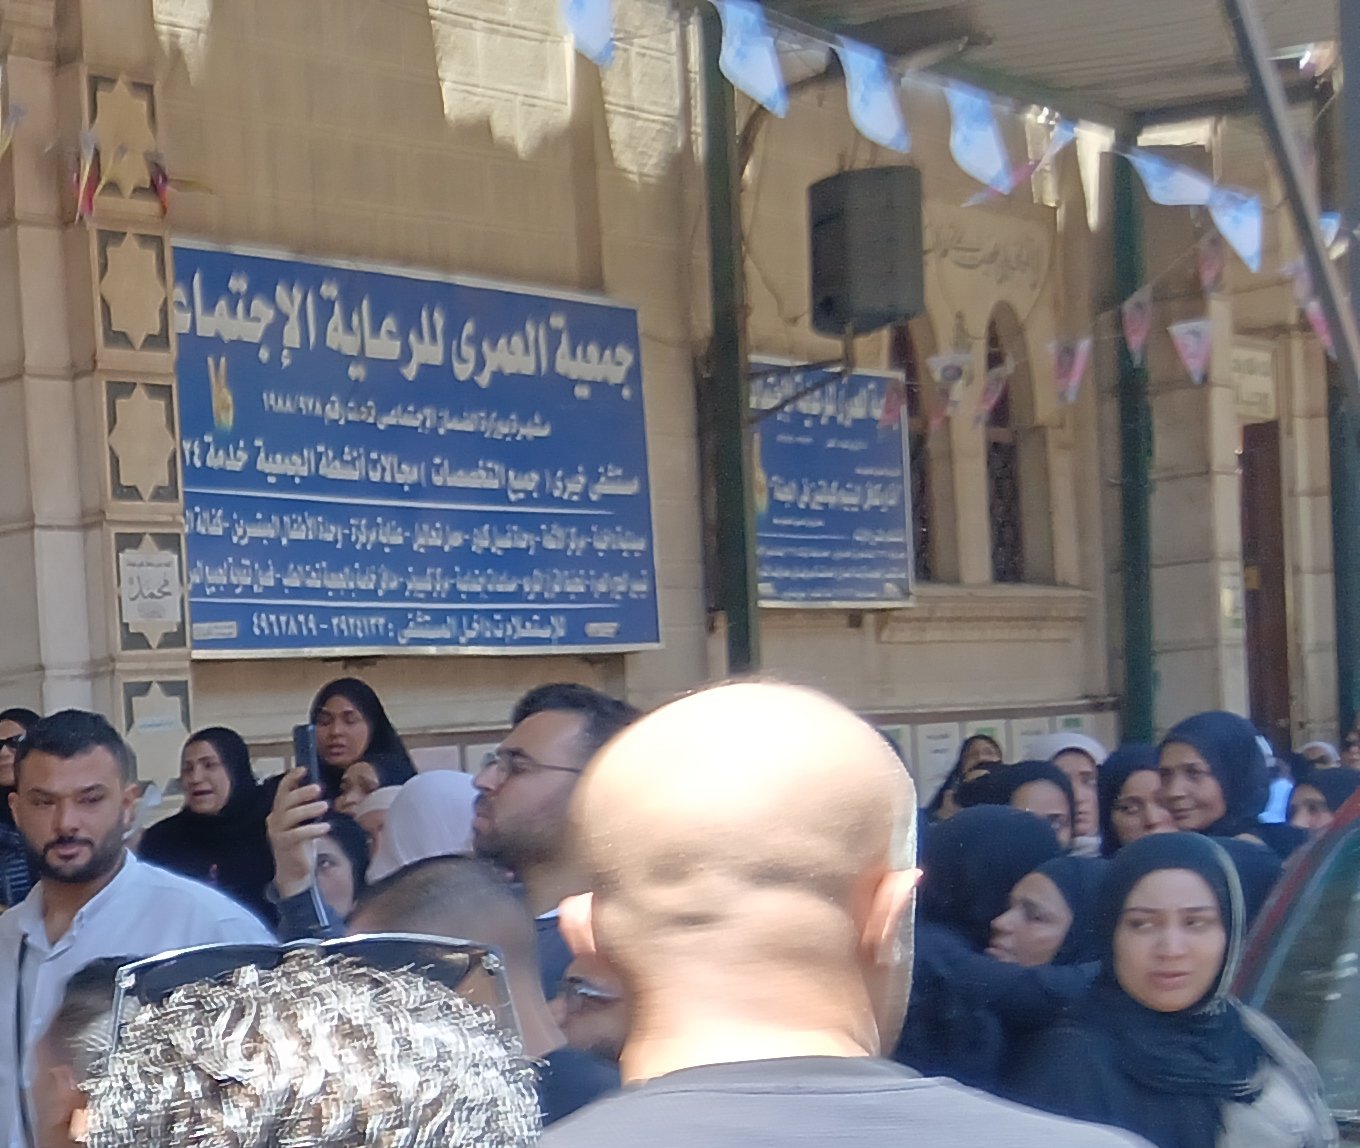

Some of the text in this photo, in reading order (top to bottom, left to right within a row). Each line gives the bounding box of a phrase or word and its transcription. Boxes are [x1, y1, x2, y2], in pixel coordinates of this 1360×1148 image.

[320, 279, 446, 382] للرعاية
[452, 307, 548, 388] العمرى
[551, 312, 635, 400] جمعية
[203, 430, 249, 472] خدمة
[254, 436, 316, 485] الجمعية
